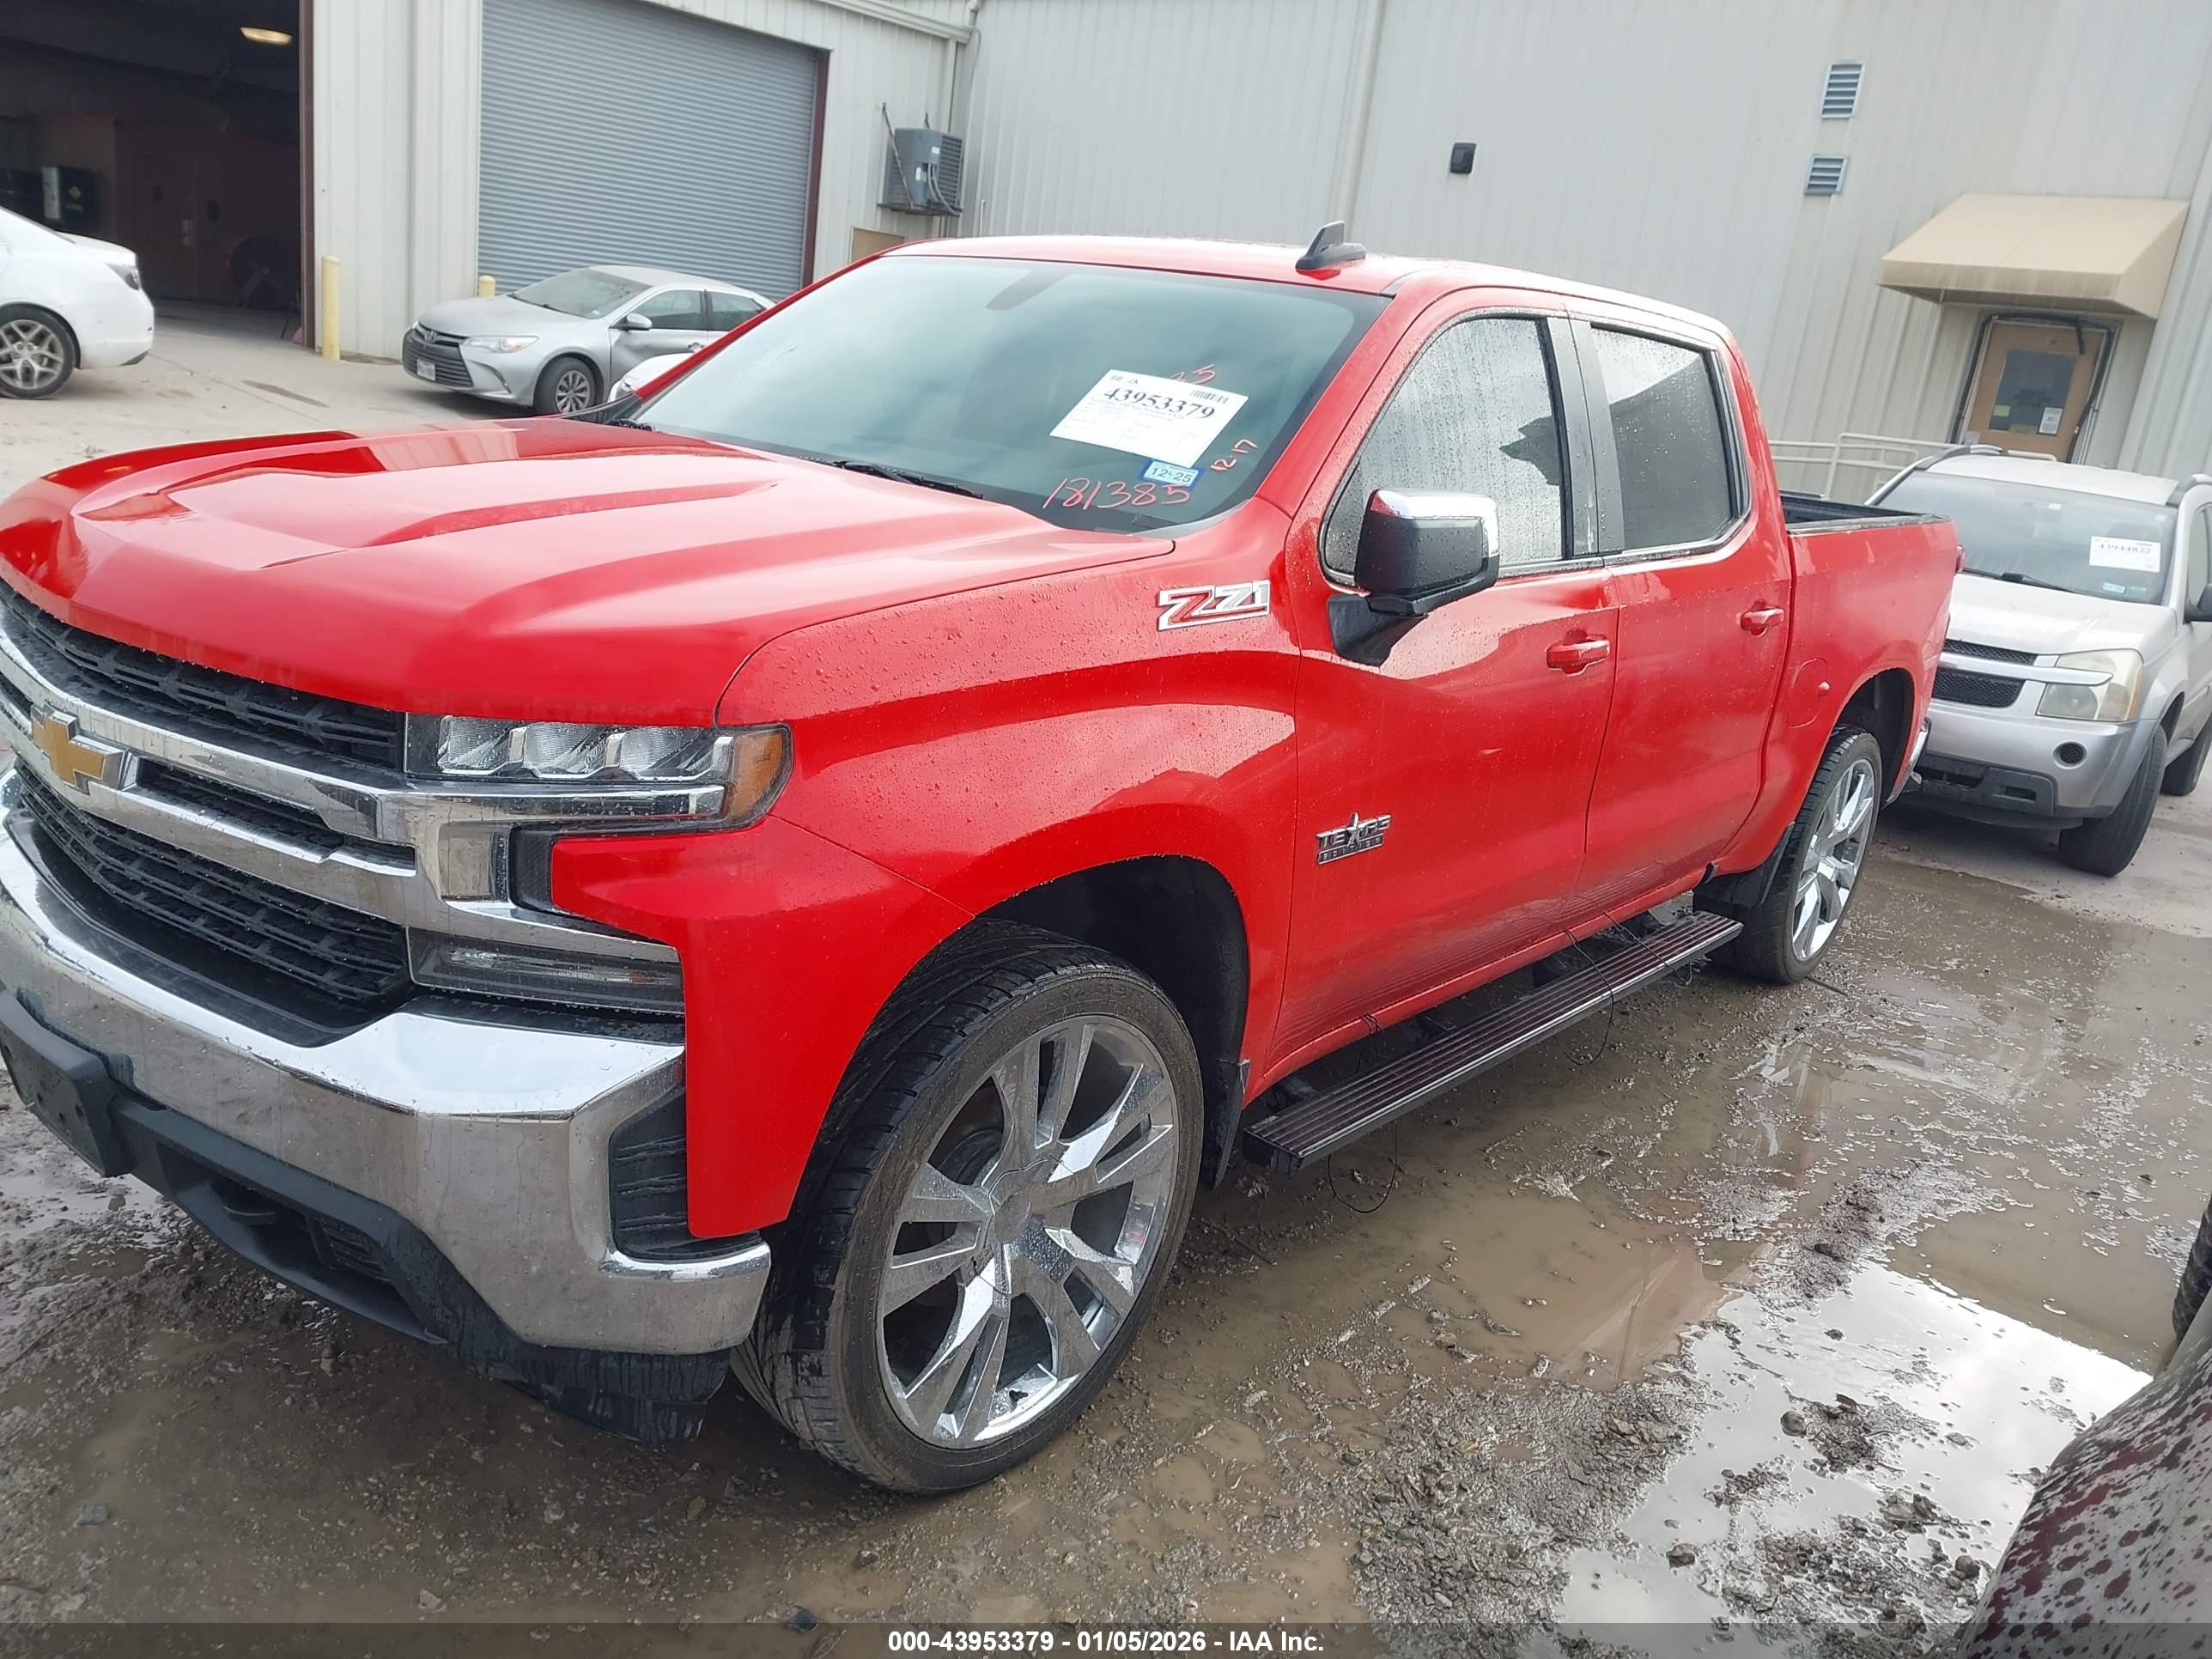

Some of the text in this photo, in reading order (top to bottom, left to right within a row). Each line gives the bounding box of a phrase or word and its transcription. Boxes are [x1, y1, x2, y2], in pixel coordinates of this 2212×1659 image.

[1103, 387, 1216, 418] 43953379
[1042, 477, 1191, 510] 181385
[1173, 472, 1193, 483] 25
[1157, 579, 1271, 632] Z71
